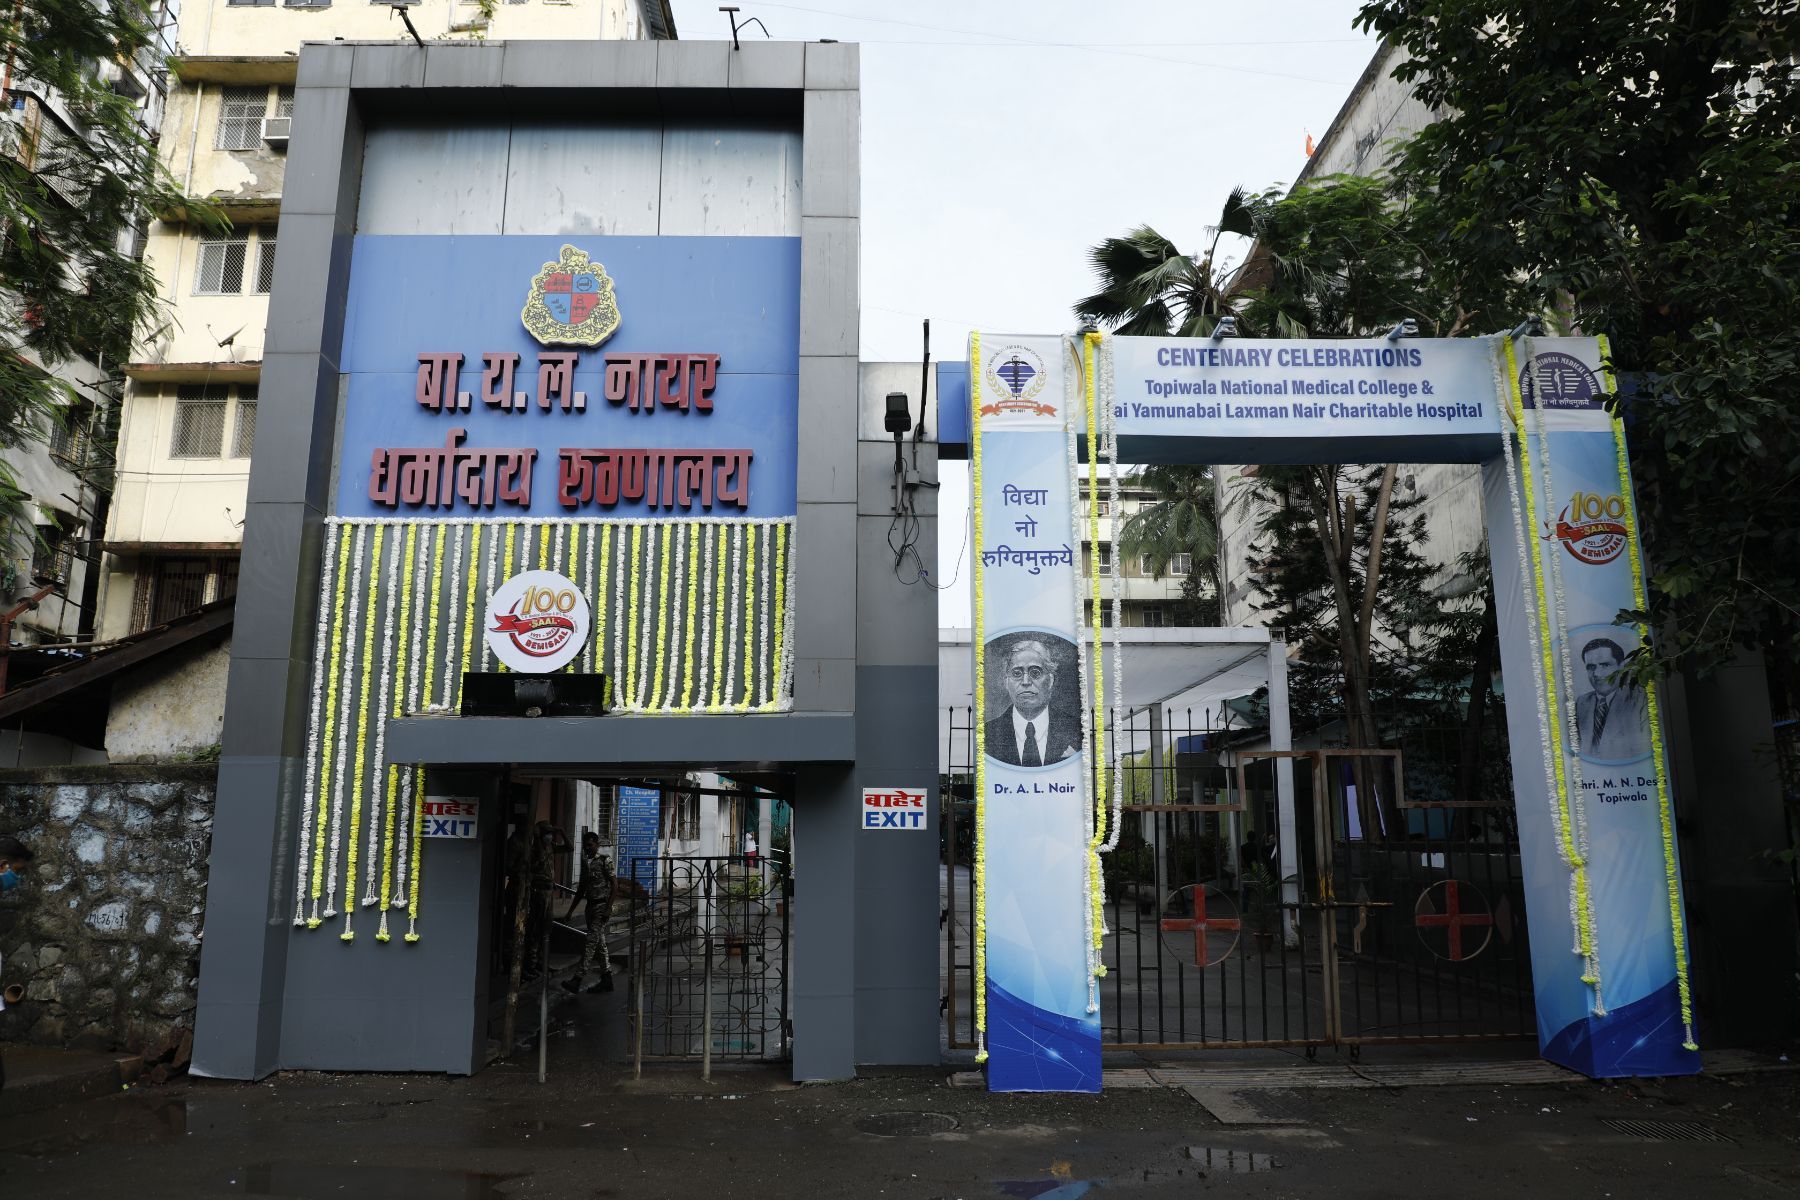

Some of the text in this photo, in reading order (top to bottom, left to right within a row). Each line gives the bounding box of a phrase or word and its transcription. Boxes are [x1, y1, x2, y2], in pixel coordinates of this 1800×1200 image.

[1157, 347, 1422, 367] CENTENARY CELEBRATIONS
[604, 352, 721, 411] नायर
[1145, 379, 1434, 398] Topiwala National Medical College &
[1114, 403, 1483, 421] ai Yamunabai Laxman Nair Charitable Hospital
[368, 428, 754, 509] धर्मादाय रुग्णालय
[1002, 484, 1048, 506] विद्या
[1569, 491, 1625, 522] 100
[1015, 514, 1038, 537] नो
[1583, 524, 1610, 536] SAAL
[1581, 537, 1623, 558] BEMISAAL
[521, 585, 576, 615] 100
[530, 617, 558, 629] SAAL
[525, 631, 568, 650] BEMISAAL
[994, 783, 1076, 794] Dr. A. L. Nair
[1603, 778, 1617, 788] M.
[1621, 777, 1634, 787] N.
[865, 790, 925, 807] बाहेर
[1597, 791, 1648, 805] Topiwala
[420, 819, 476, 836] EXIT
[866, 811, 924, 827] EXIT
